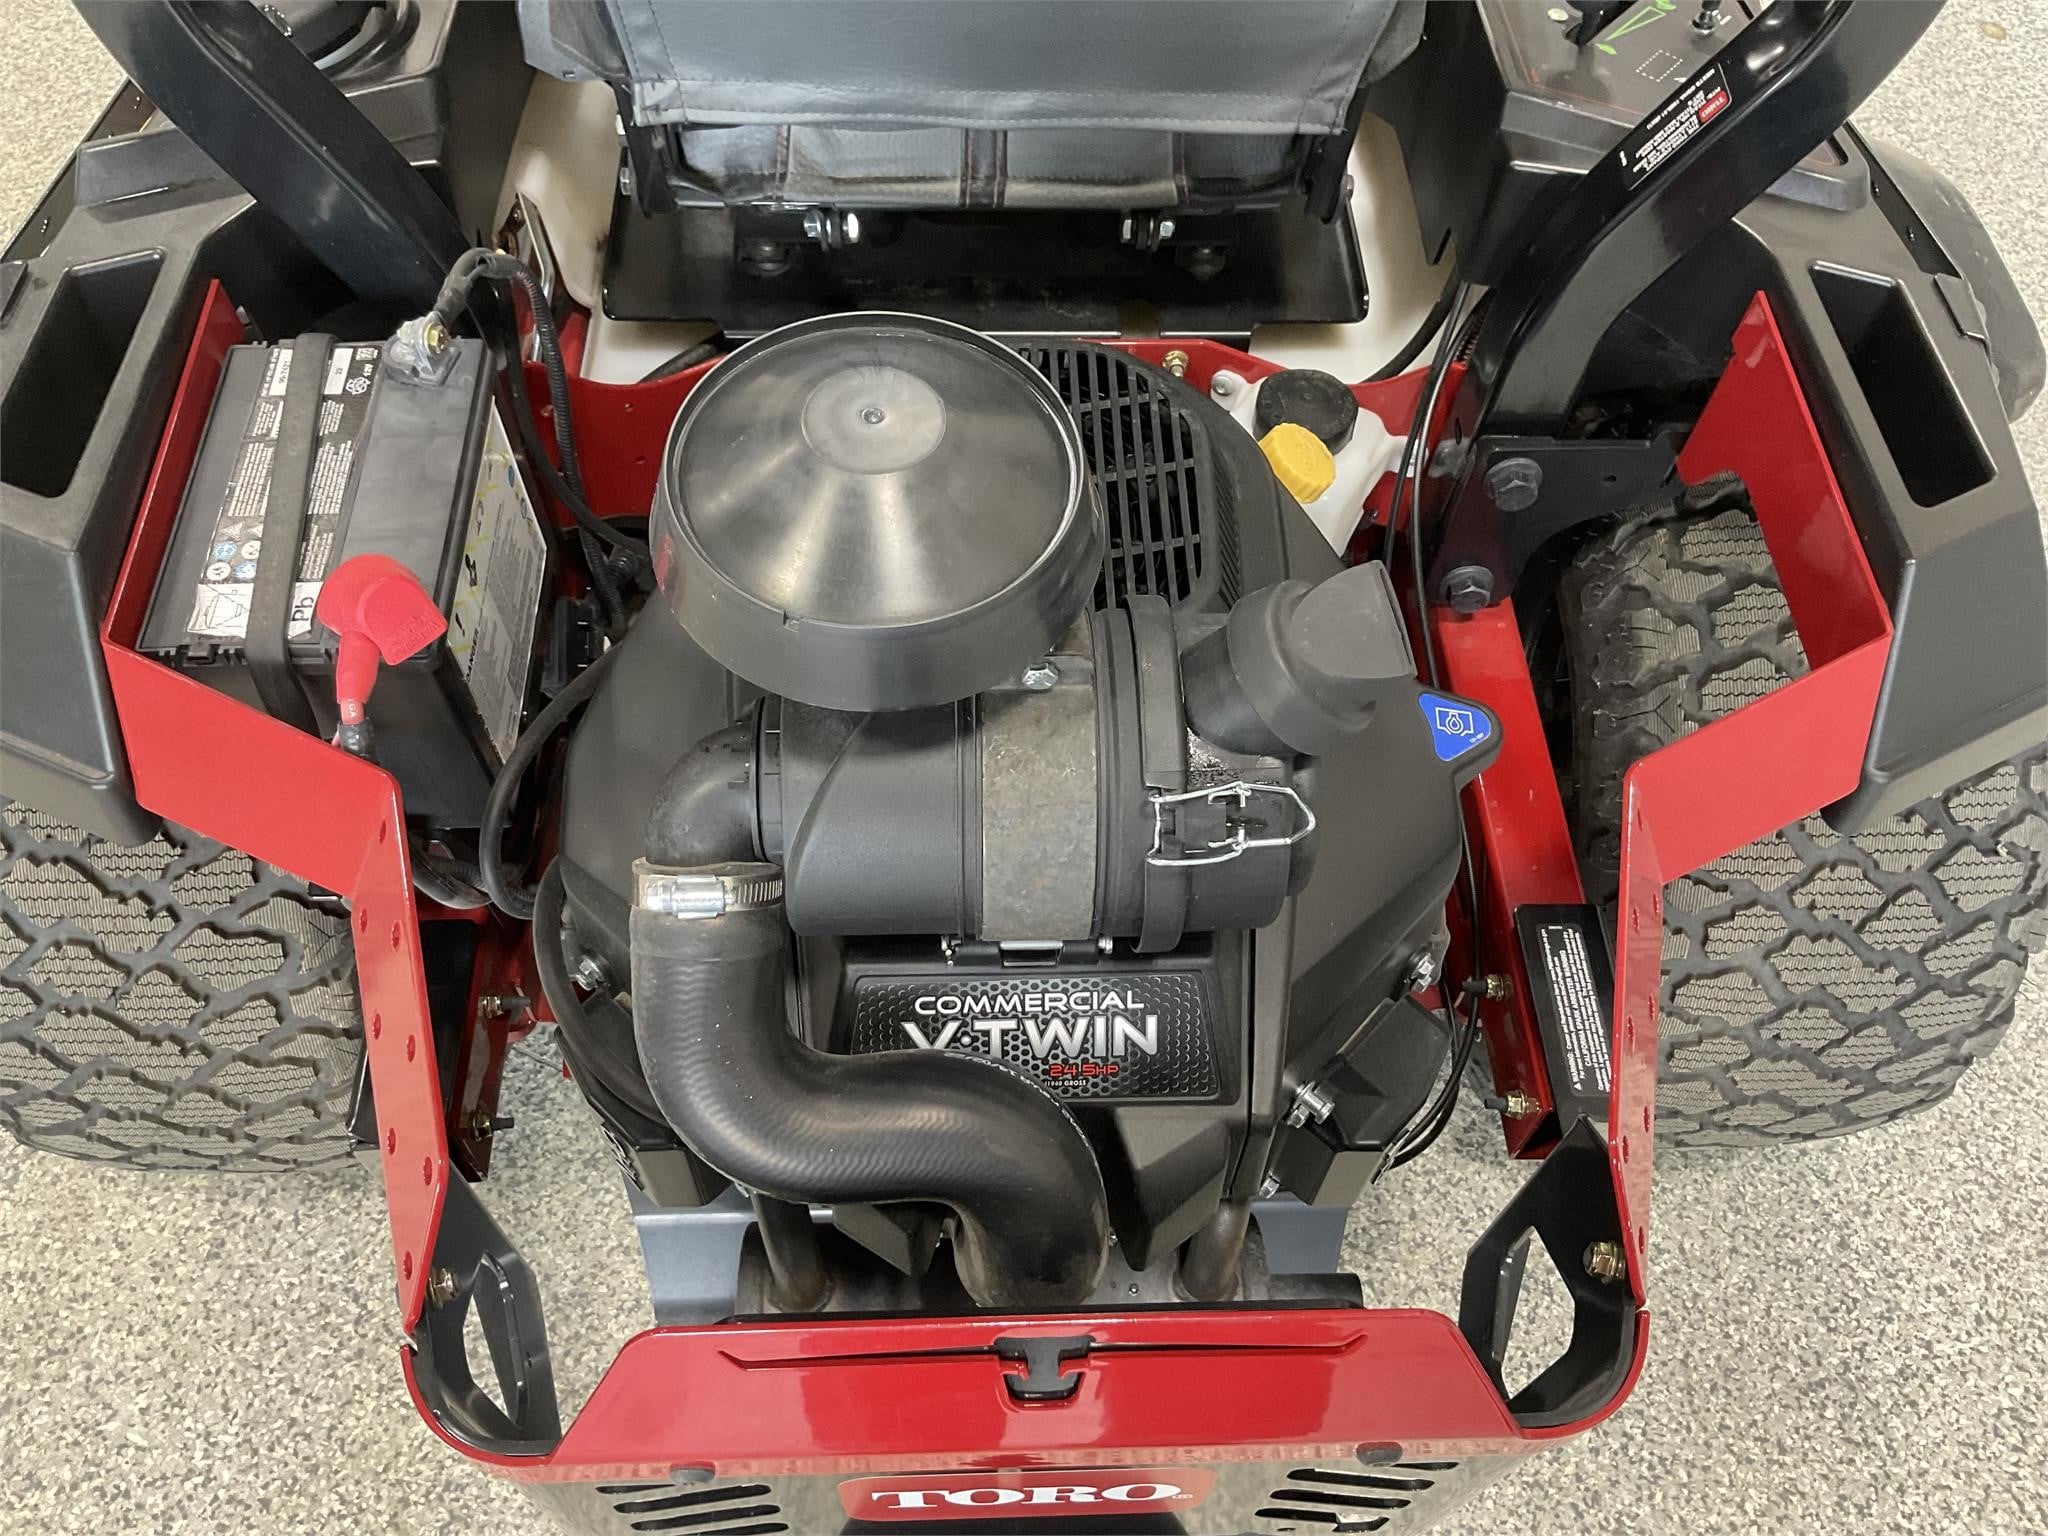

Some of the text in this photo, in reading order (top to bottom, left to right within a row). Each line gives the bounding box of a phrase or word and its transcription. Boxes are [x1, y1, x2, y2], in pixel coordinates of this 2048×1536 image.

[292, 597, 314, 622] Pb
[915, 990, 1145, 1015] COMMERCIAL
[872, 1483, 1182, 1508] TORO
